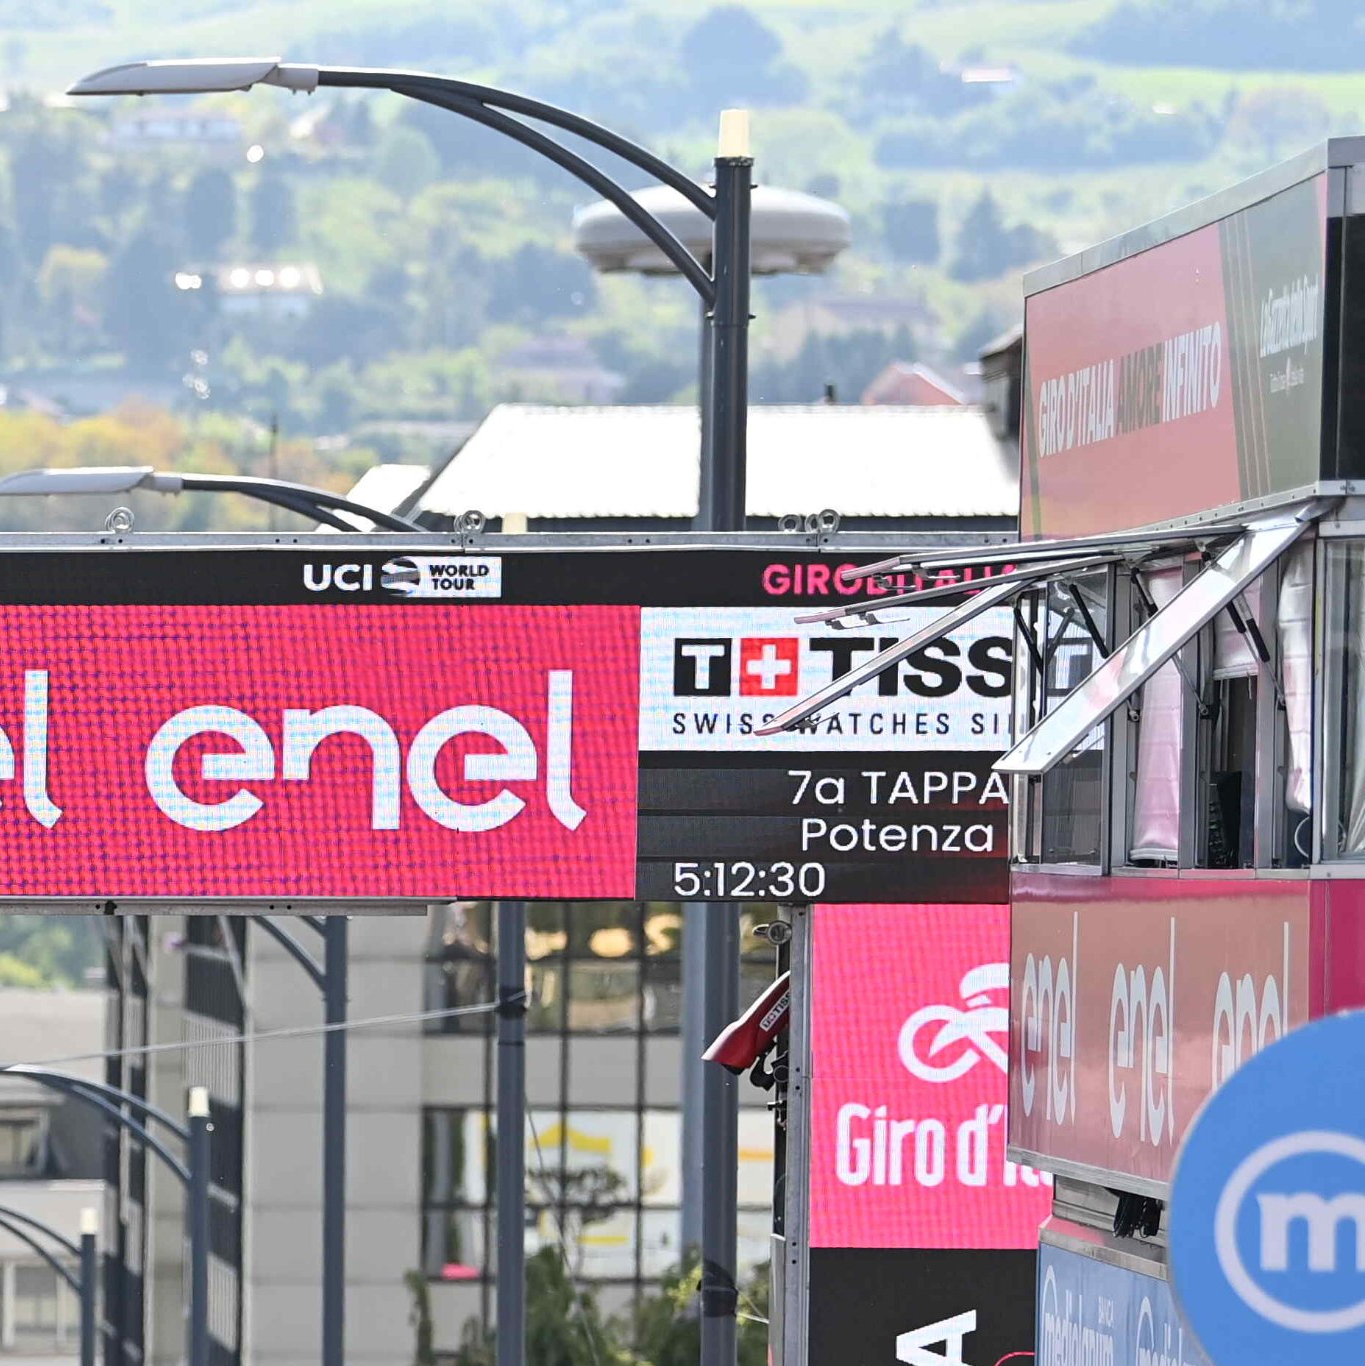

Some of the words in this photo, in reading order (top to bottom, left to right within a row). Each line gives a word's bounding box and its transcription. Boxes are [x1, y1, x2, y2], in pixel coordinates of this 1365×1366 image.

[1039, 378, 1066, 458] GIRO
[1162, 321, 1221, 423] INFINITO
[303, 563, 373, 592] UCI
[428, 564, 490, 578] WORLD
[431, 577, 476, 591] TOUR
[810, 636, 1013, 698] TISS
[145, 669, 587, 832] enel
[787, 770, 846, 805] 7a
[862, 771, 1010, 805] TAPPA
[801, 818, 995, 853] Potenza
[673, 862, 827, 898] 5:12:30
[1021, 911, 1078, 1128] enel
[1109, 916, 1176, 1147] enel
[835, 1103, 945, 1187] Giro
